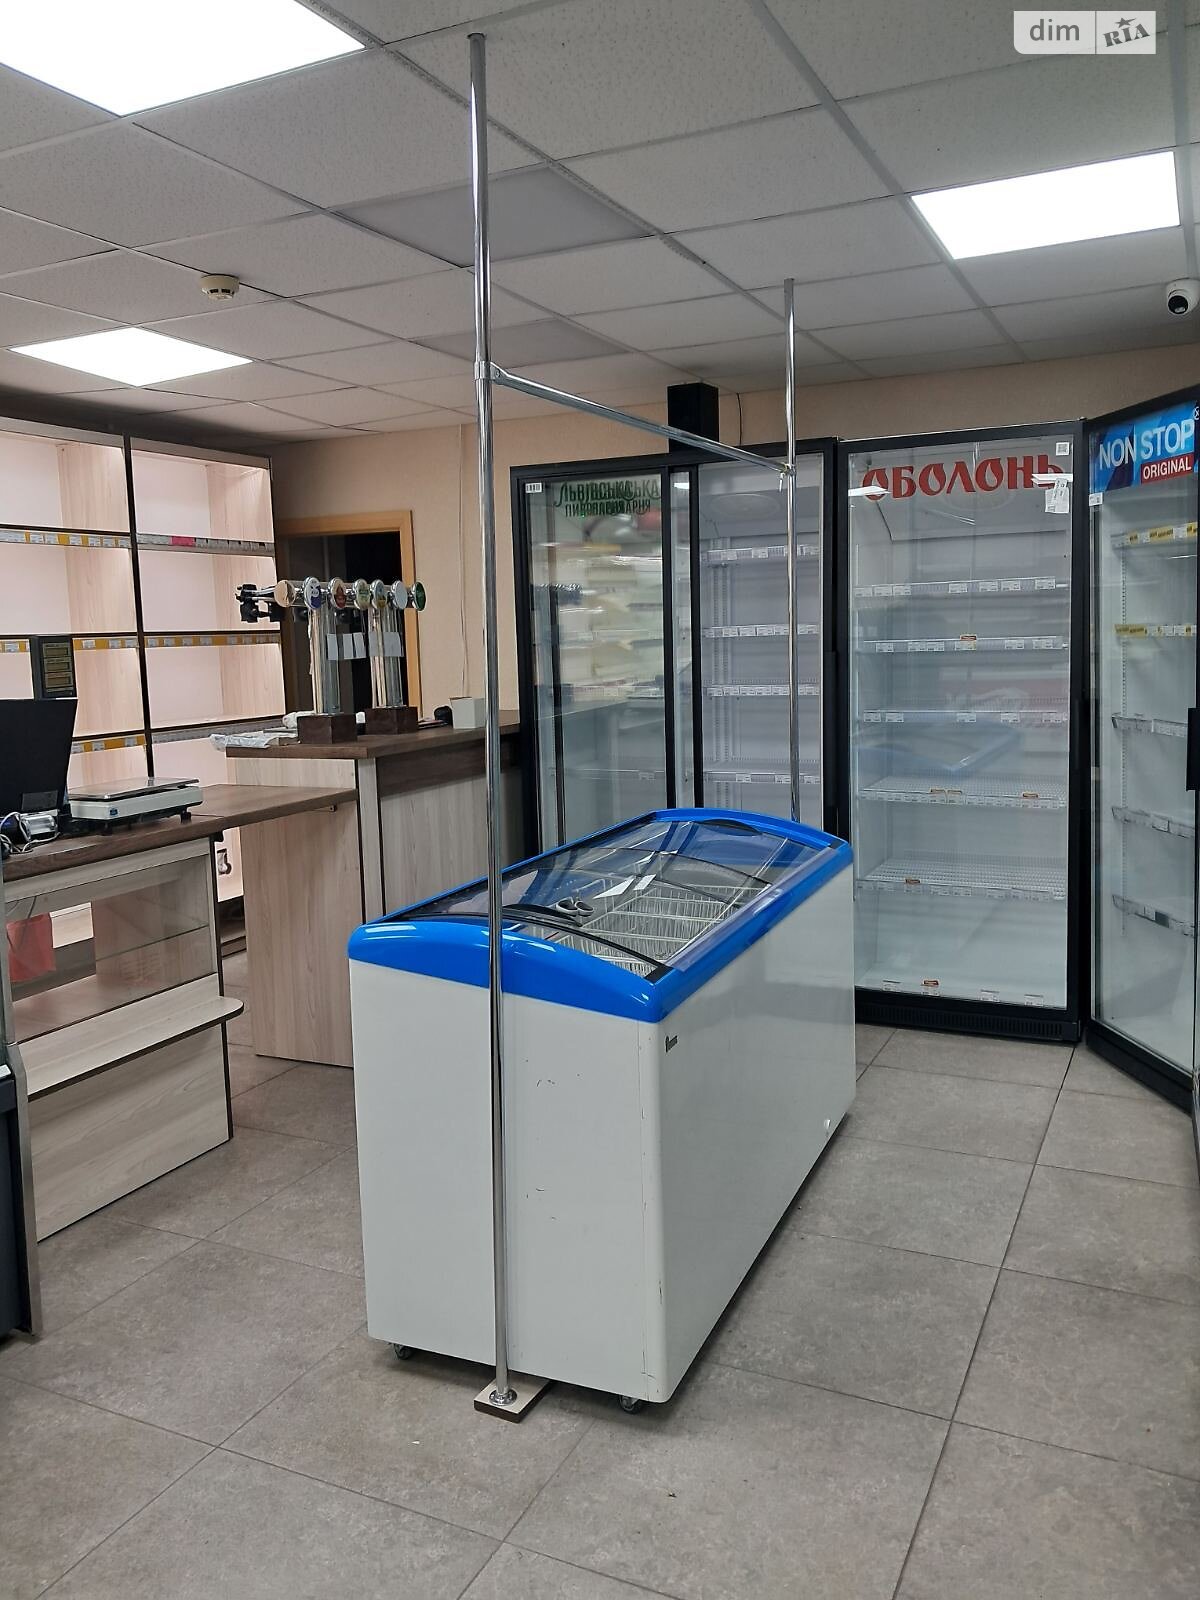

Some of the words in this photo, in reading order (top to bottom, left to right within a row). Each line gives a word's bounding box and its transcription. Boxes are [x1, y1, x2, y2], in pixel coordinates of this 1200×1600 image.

[1099, 436, 1137, 470] NON
[1141, 419, 1195, 460] STOP
[862, 455, 1064, 500] ОБОЛОНЬ
[1143, 457, 1192, 480] ORIGINAL
